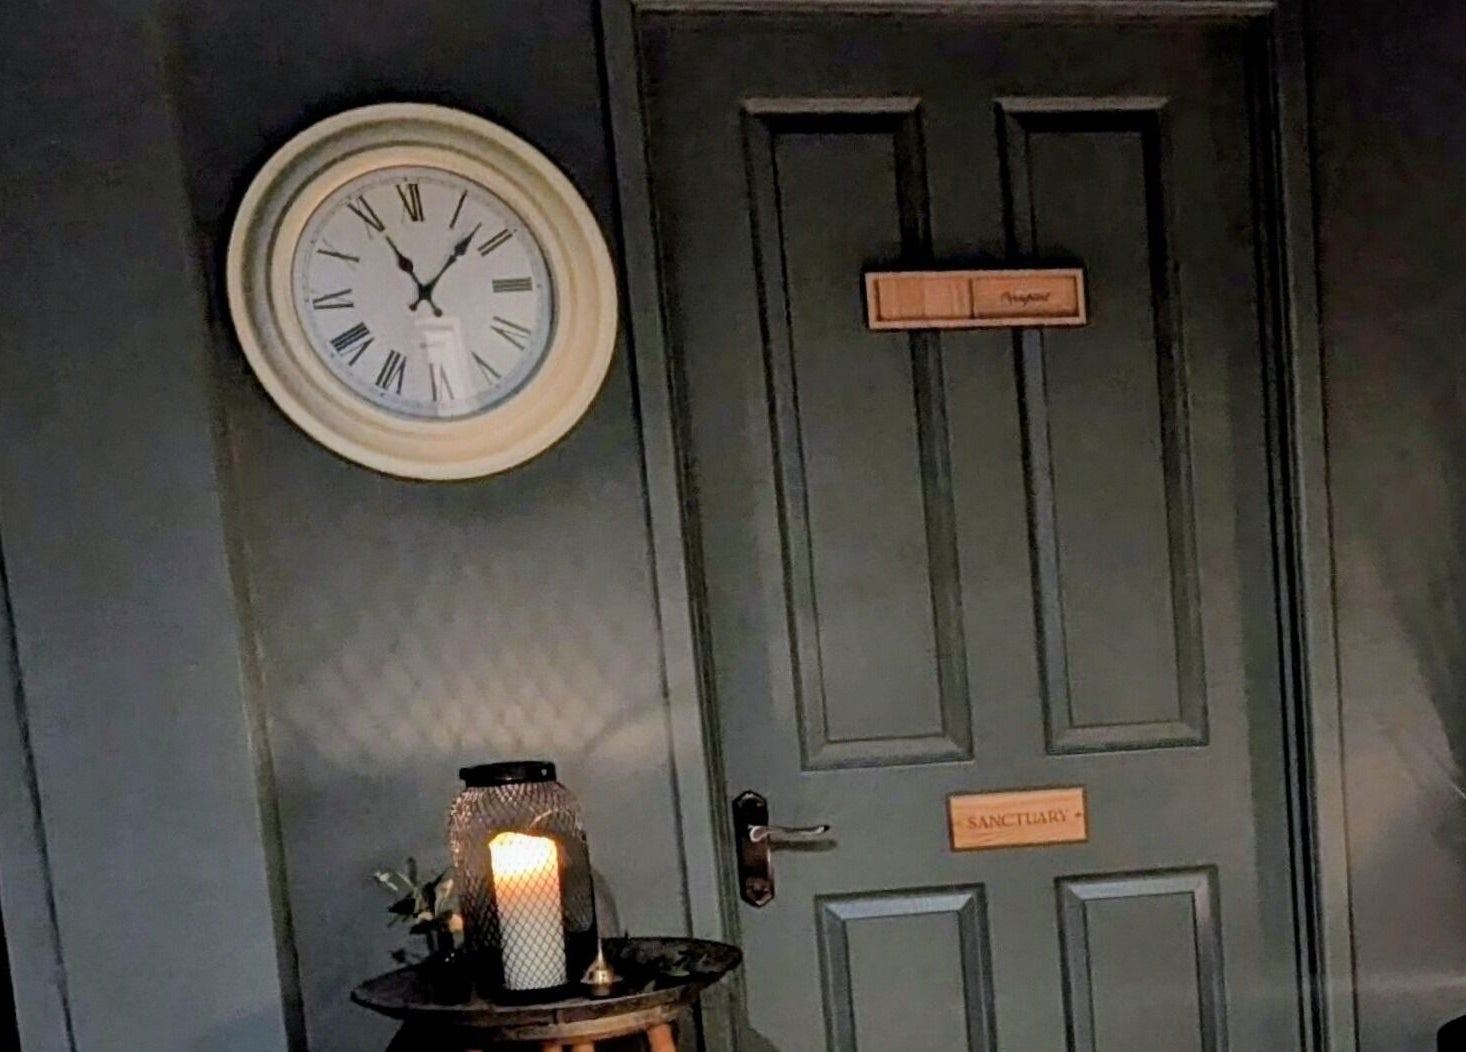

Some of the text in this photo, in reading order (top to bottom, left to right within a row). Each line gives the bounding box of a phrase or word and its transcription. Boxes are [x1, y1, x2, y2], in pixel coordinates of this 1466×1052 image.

[347, 194, 386, 241] XI
[396, 183, 425, 224] XII
[317, 237, 360, 273] X
[477, 228, 514, 257] II
[491, 276, 533, 293] III
[329, 321, 376, 367] VIII
[489, 315, 532, 351] IV
[375, 349, 408, 395] VII
[428, 362, 456, 403] VI
[470, 350, 503, 387] V
[967, 809, 1068, 829] SANCTUARY
